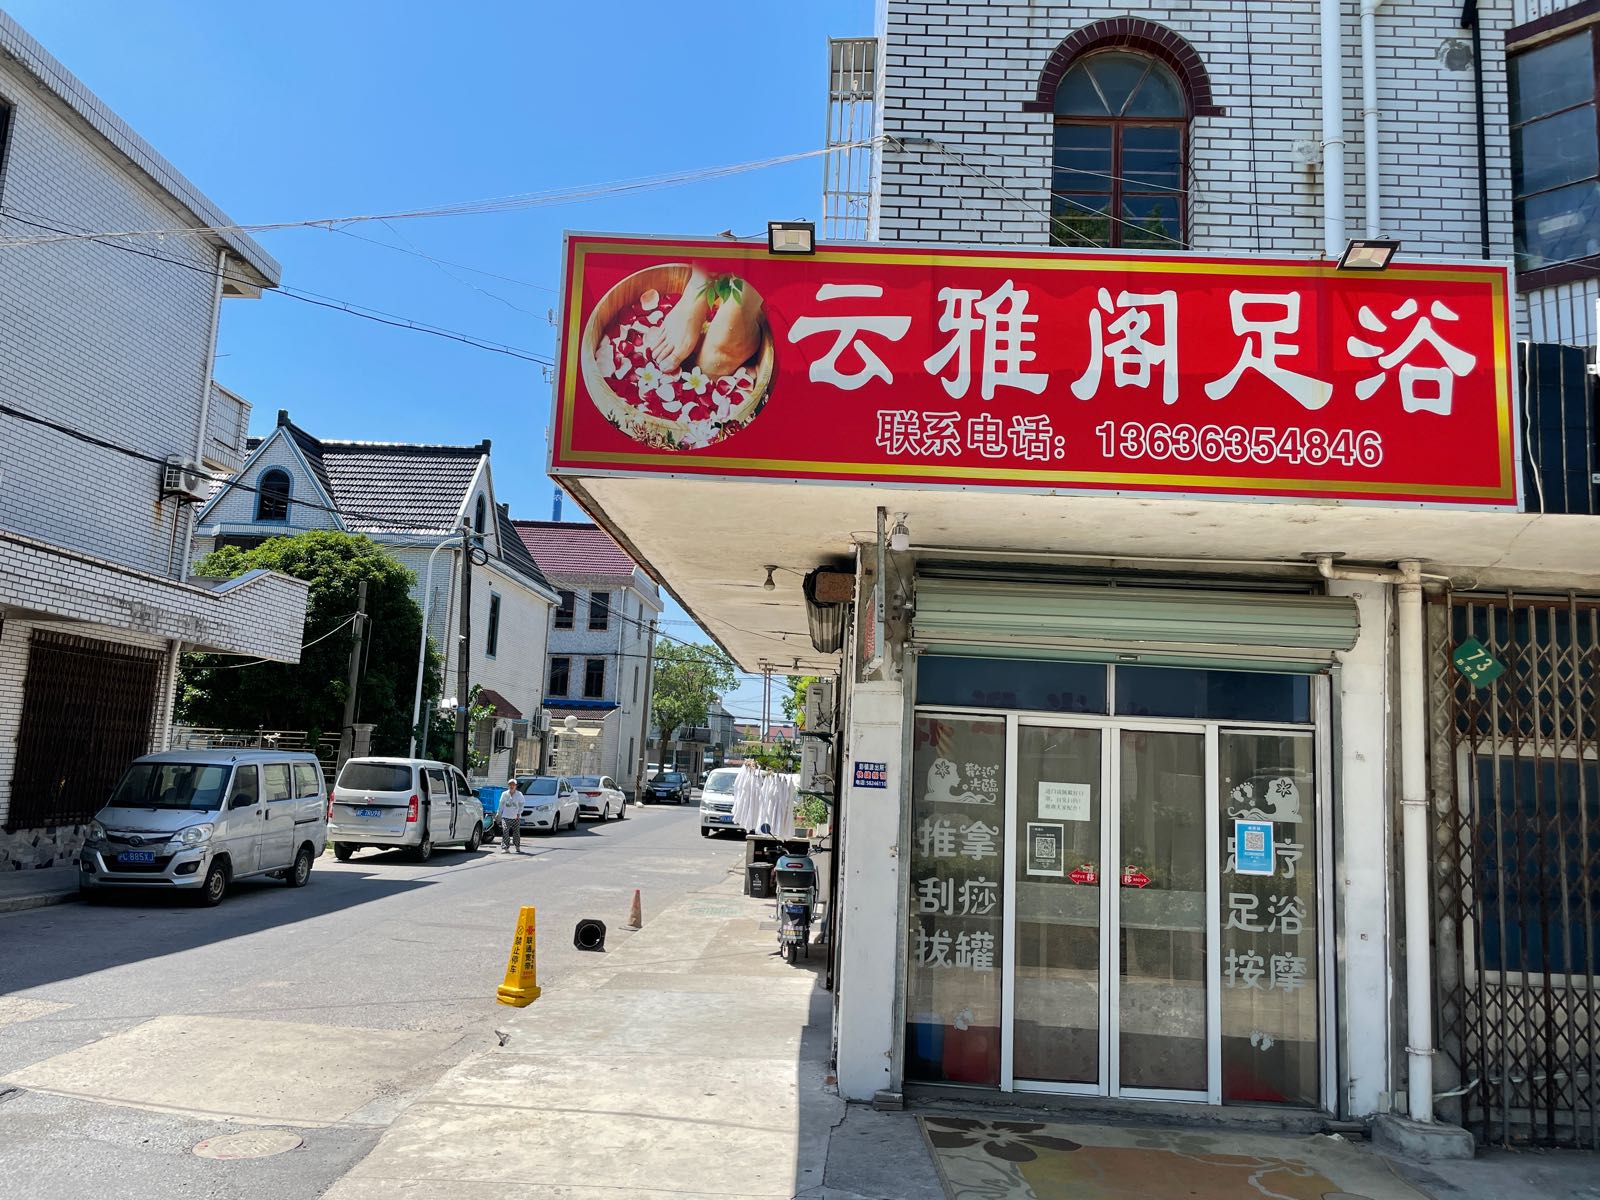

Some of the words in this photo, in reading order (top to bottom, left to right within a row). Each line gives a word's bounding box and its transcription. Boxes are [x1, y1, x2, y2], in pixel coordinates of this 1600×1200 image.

[787, 279, 1476, 416] 云雅阁足浴
[876, 409, 1065, 461] 联系电话:
[1096, 420, 1382, 467] 13636354846
[918, 818, 1000, 861] 推拿
[1223, 836, 1305, 879] 疗
[918, 876, 998, 916] 刮痧
[1223, 892, 1307, 935] 足浴
[914, 927, 995, 972] 拔罐
[1224, 948, 1308, 993] 按摩
